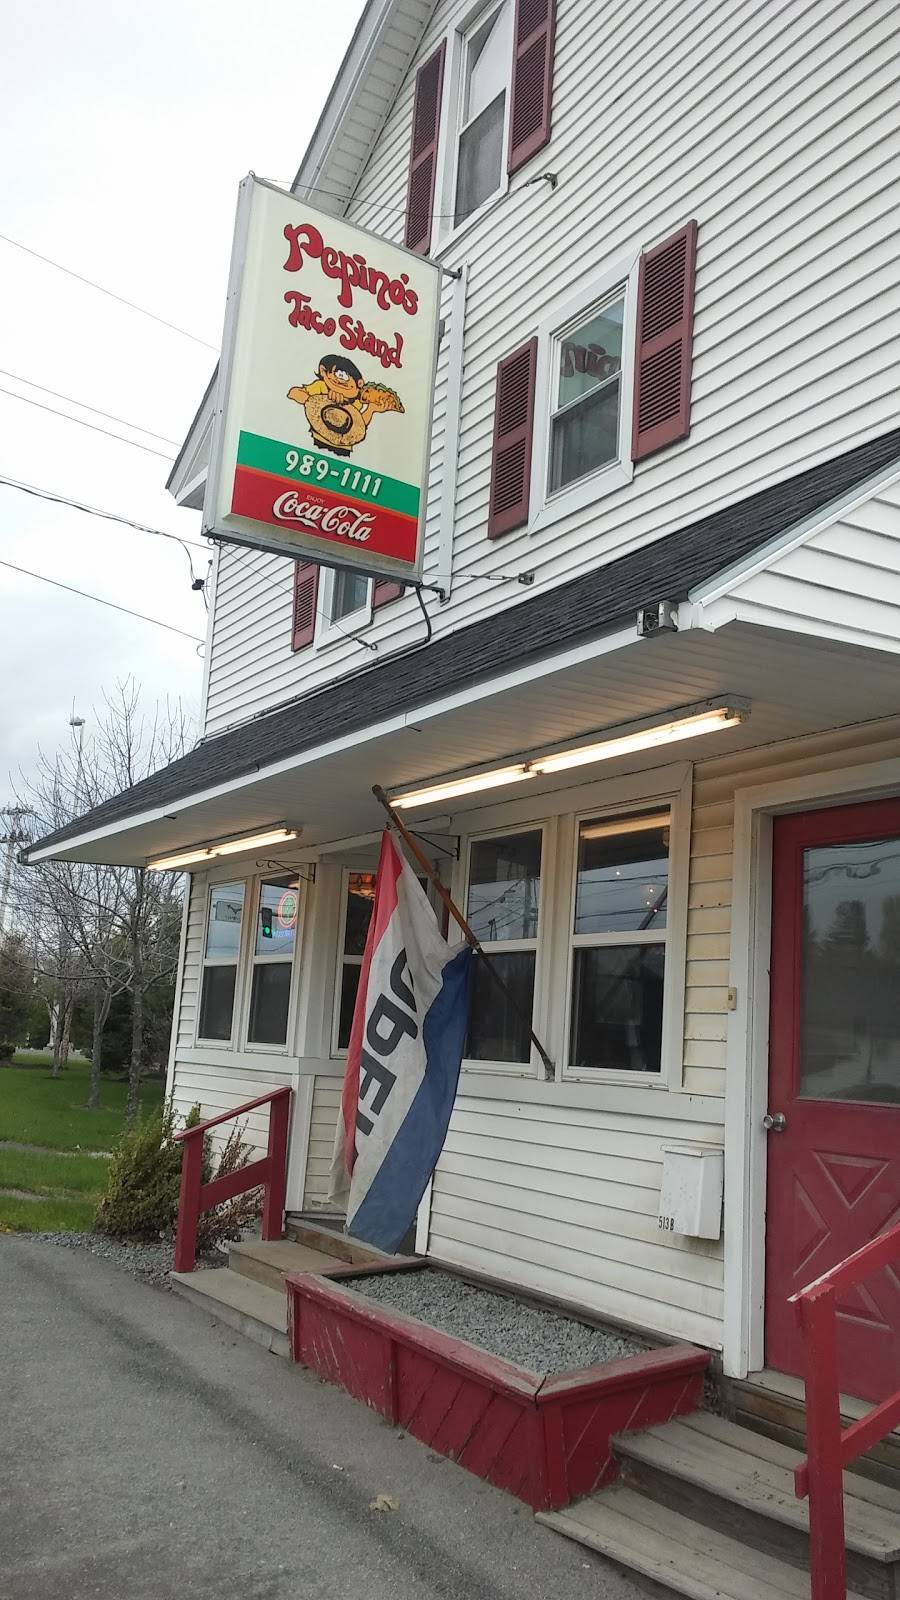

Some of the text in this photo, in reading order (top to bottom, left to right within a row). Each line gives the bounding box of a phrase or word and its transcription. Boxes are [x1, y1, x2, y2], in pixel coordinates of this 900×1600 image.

[284, 223, 419, 315] Pepino's
[284, 290, 404, 369] Taco Stand
[285, 450, 382, 497] 989-1111
[306, 494, 326, 504] ENJOY
[272, 490, 377, 541] Coca-Cola
